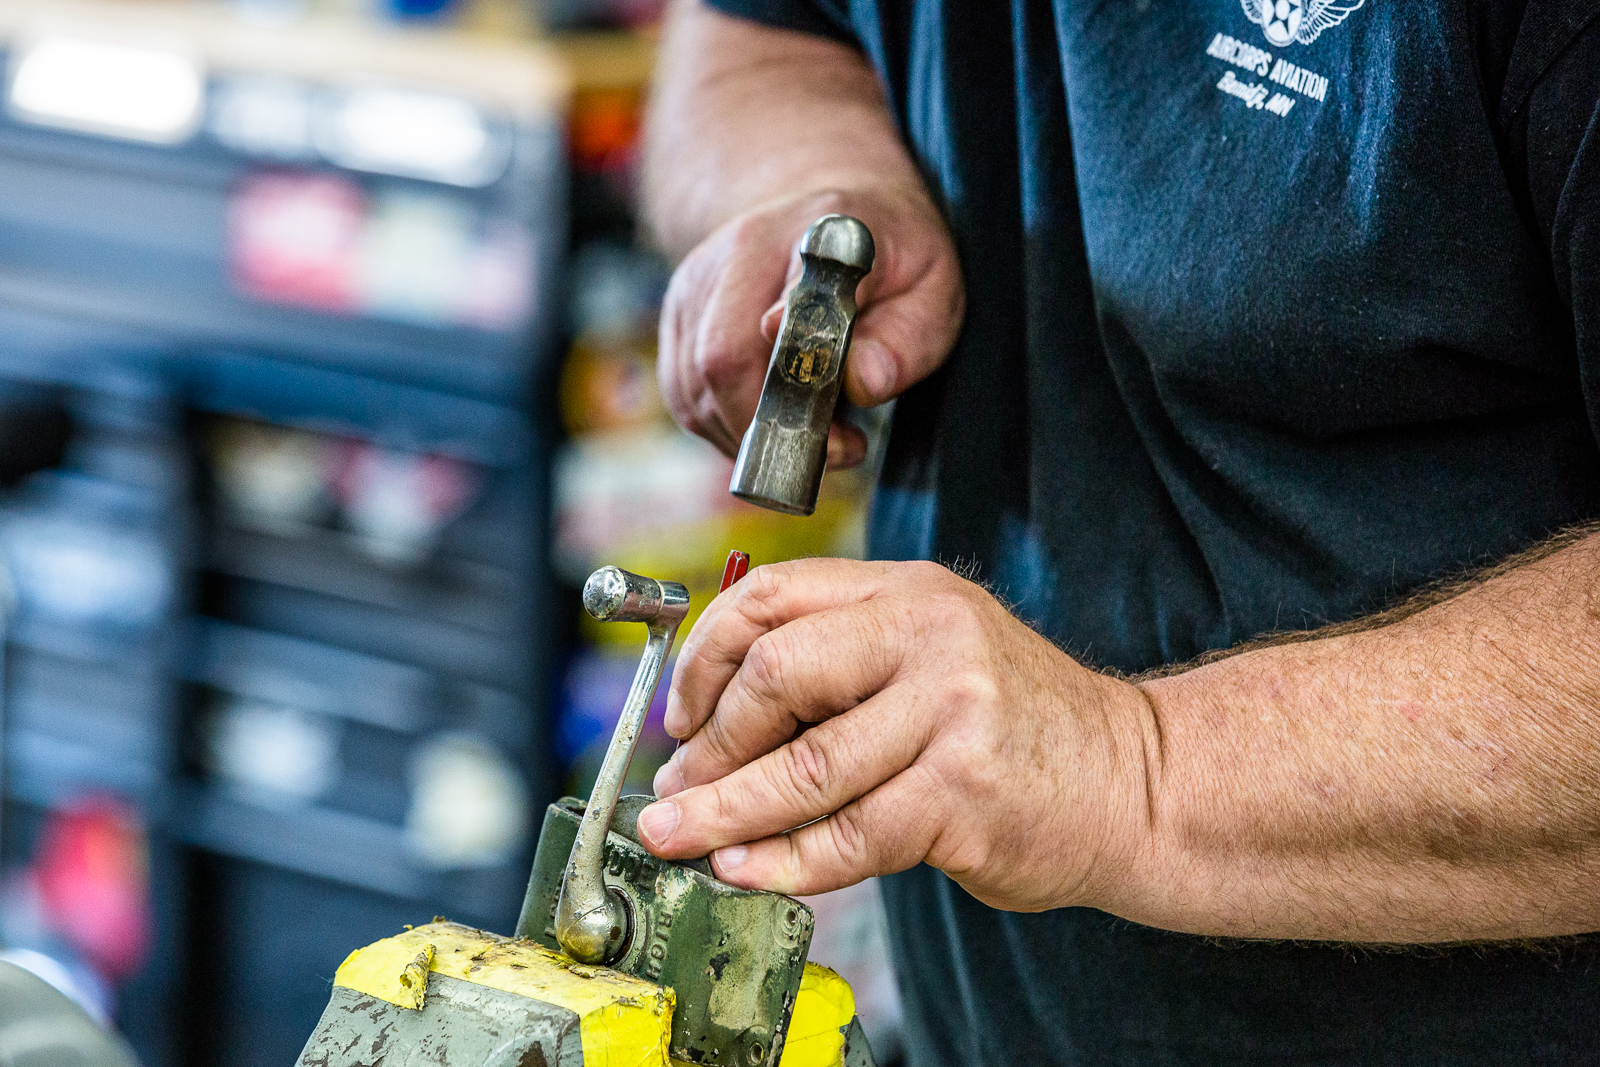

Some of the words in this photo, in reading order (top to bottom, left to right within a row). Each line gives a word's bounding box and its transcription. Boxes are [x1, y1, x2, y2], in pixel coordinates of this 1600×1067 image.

[1206, 32, 1273, 77] AIRCORPS
[1268, 58, 1329, 102] AVIATION
[1264, 92, 1296, 117] MN
[646, 911, 674, 981] RIGH
